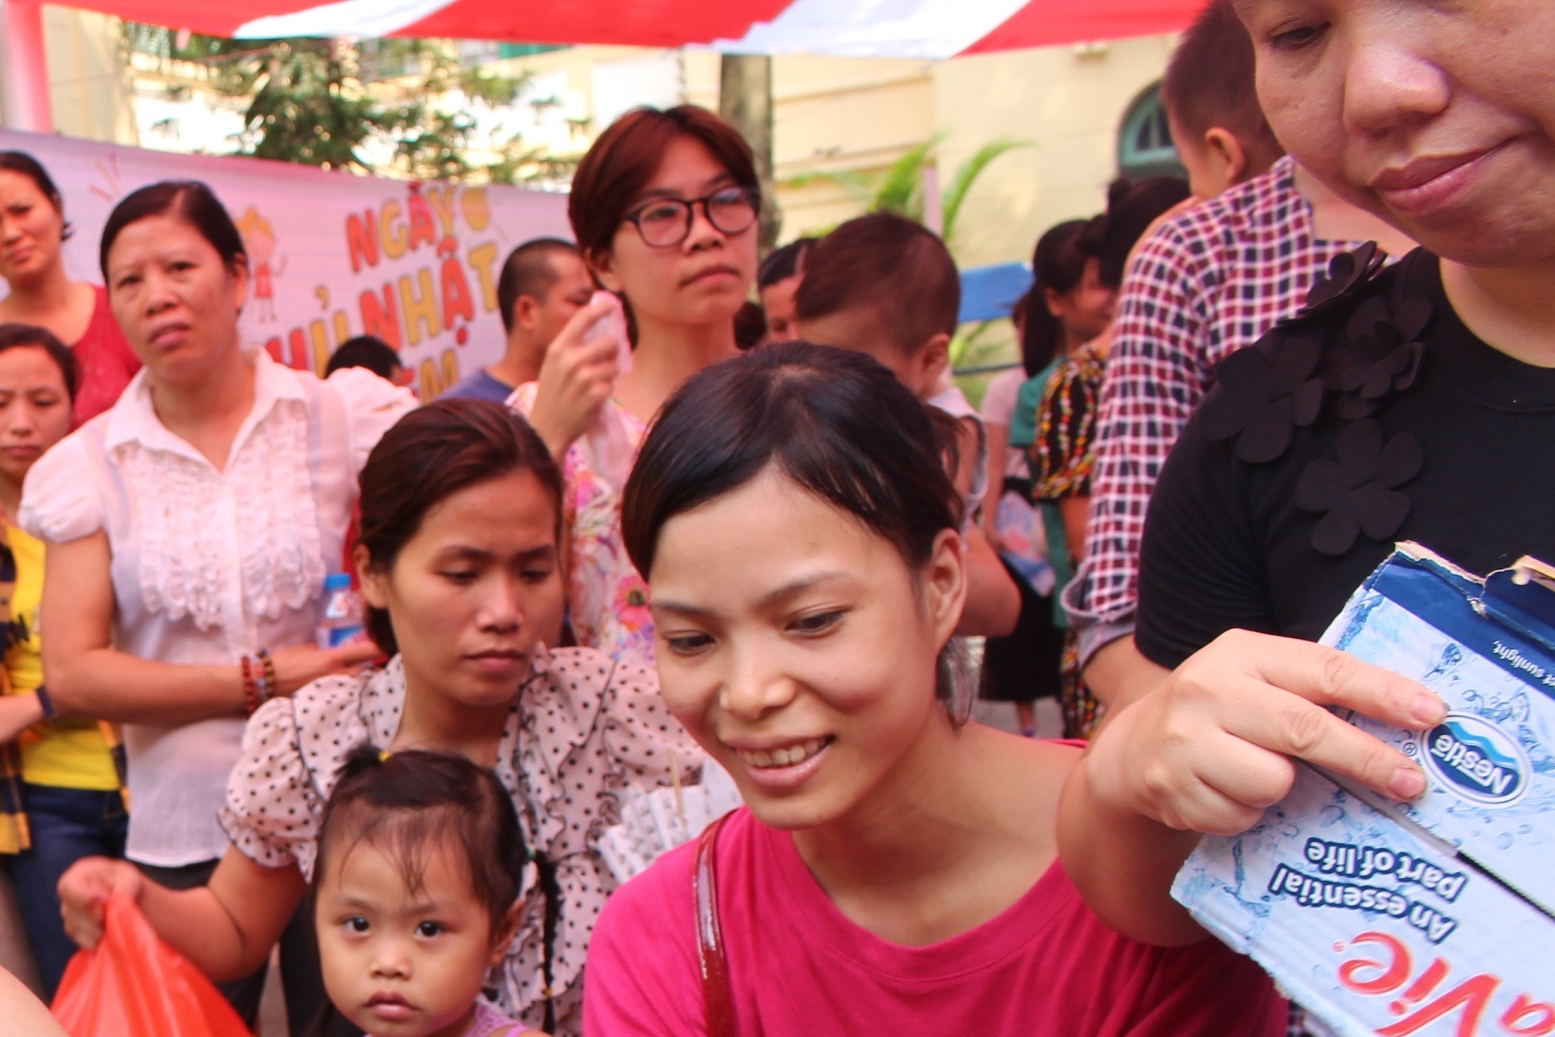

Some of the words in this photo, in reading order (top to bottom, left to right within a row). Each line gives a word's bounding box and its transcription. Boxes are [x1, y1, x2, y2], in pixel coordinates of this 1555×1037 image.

[359, 236, 498, 351] NHẬT
[1306, 839, 1357, 877] life
[1358, 847, 1395, 878] of
[1395, 853, 1467, 902] part
[1269, 864, 1408, 918] essential
[1409, 902, 1457, 943] An
